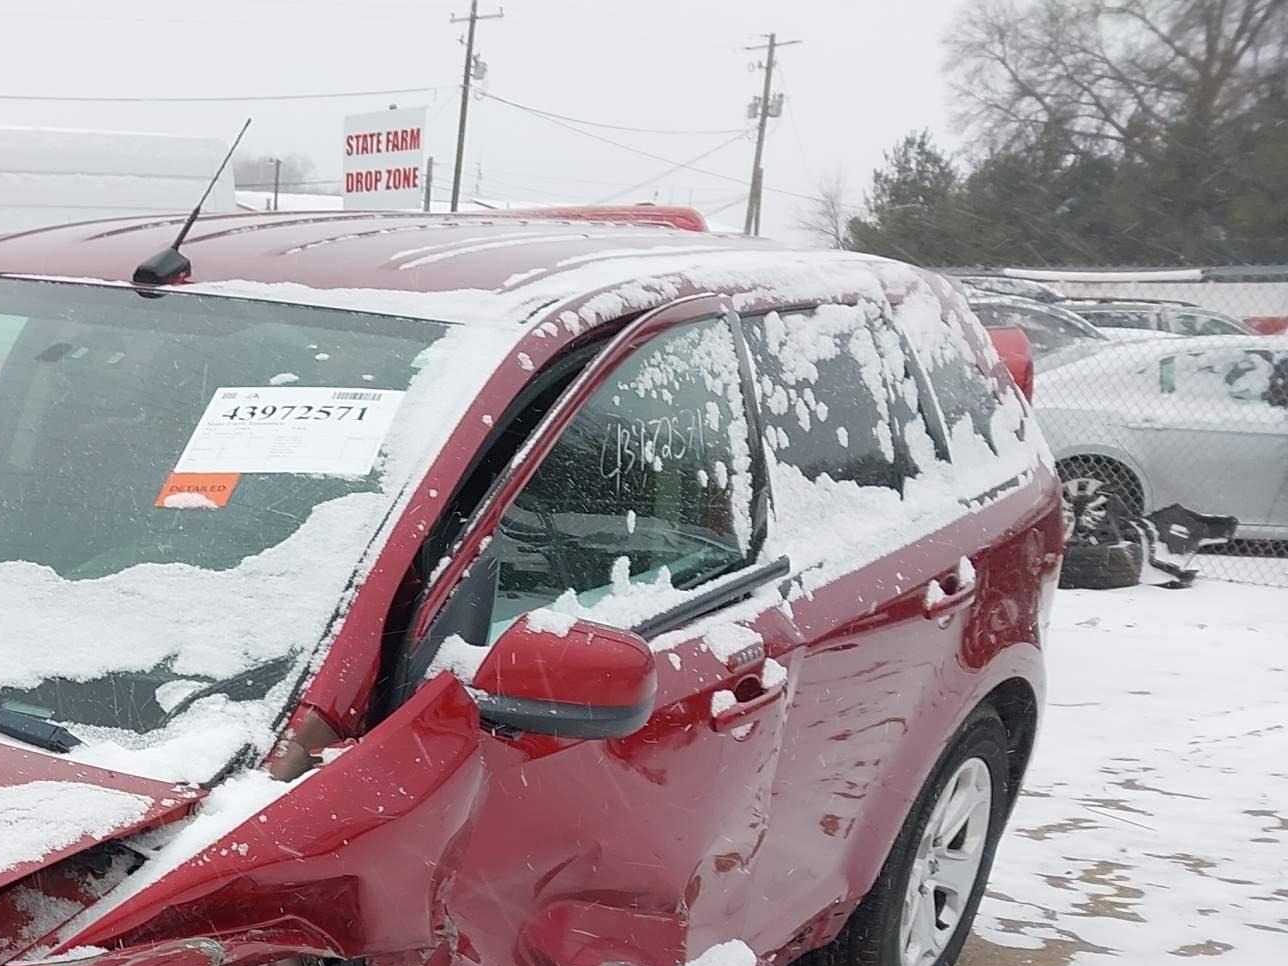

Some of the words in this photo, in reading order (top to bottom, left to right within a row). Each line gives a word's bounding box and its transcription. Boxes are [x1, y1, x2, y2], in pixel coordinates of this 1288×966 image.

[345, 132, 383, 157] STATE
[386, 127, 421, 153] FARM
[345, 170, 382, 193] DROP
[385, 167, 419, 191] ZONE
[221, 404, 370, 422] 43972571
[168, 484, 227, 494] DETAILED
